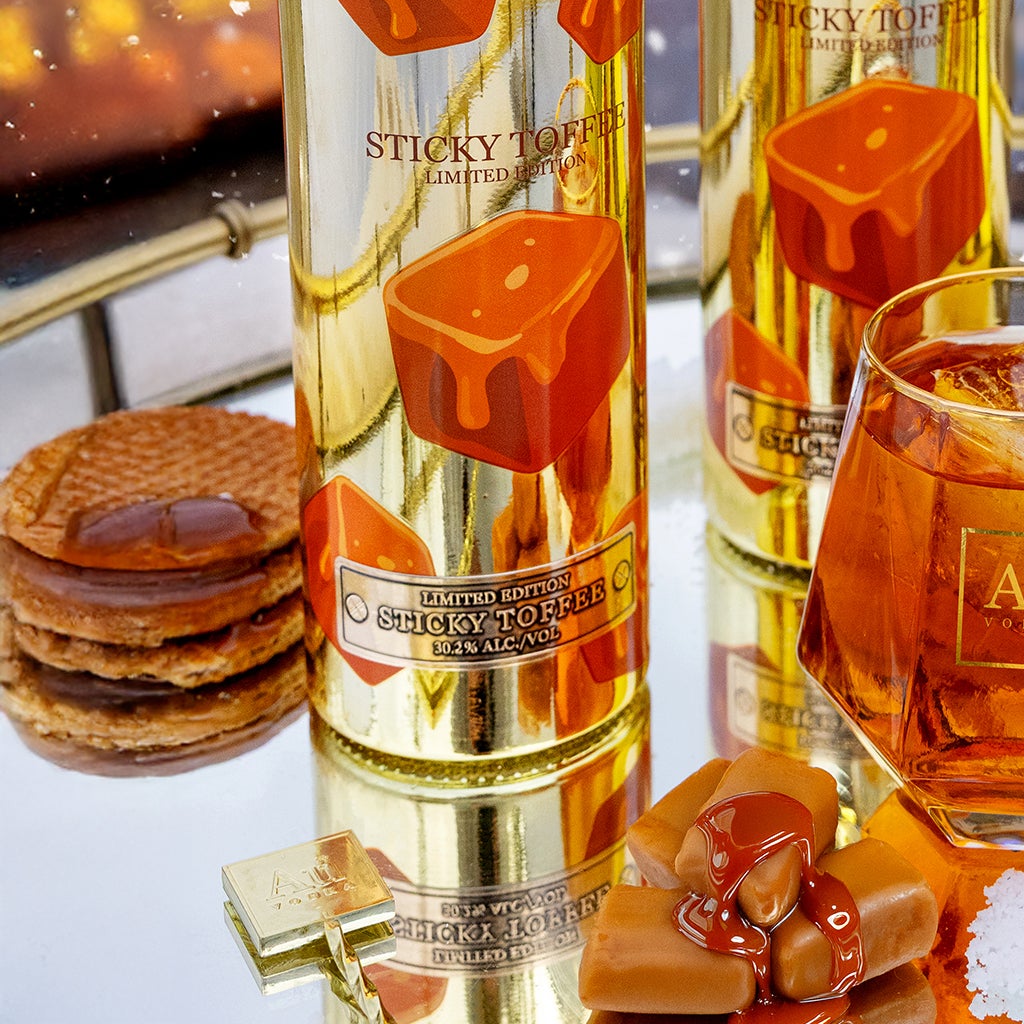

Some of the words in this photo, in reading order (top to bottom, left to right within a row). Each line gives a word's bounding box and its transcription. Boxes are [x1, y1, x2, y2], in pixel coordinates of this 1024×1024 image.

[366, 131, 500, 163] STICKY
[509, 102, 626, 159] TOFFEE
[425, 167, 509, 185] LIMITED
[514, 151, 587, 180] EDITION
[759, 427, 840, 459] STICK
[421, 590, 497, 607] LIMITED
[501, 573, 571, 602] EDITION
[377, 605, 488, 636] STICKY
[495, 579, 606, 629] TOFFEE
[433, 639, 478, 656] 30.2%
[482, 628, 560, 653] ALC./VOL
